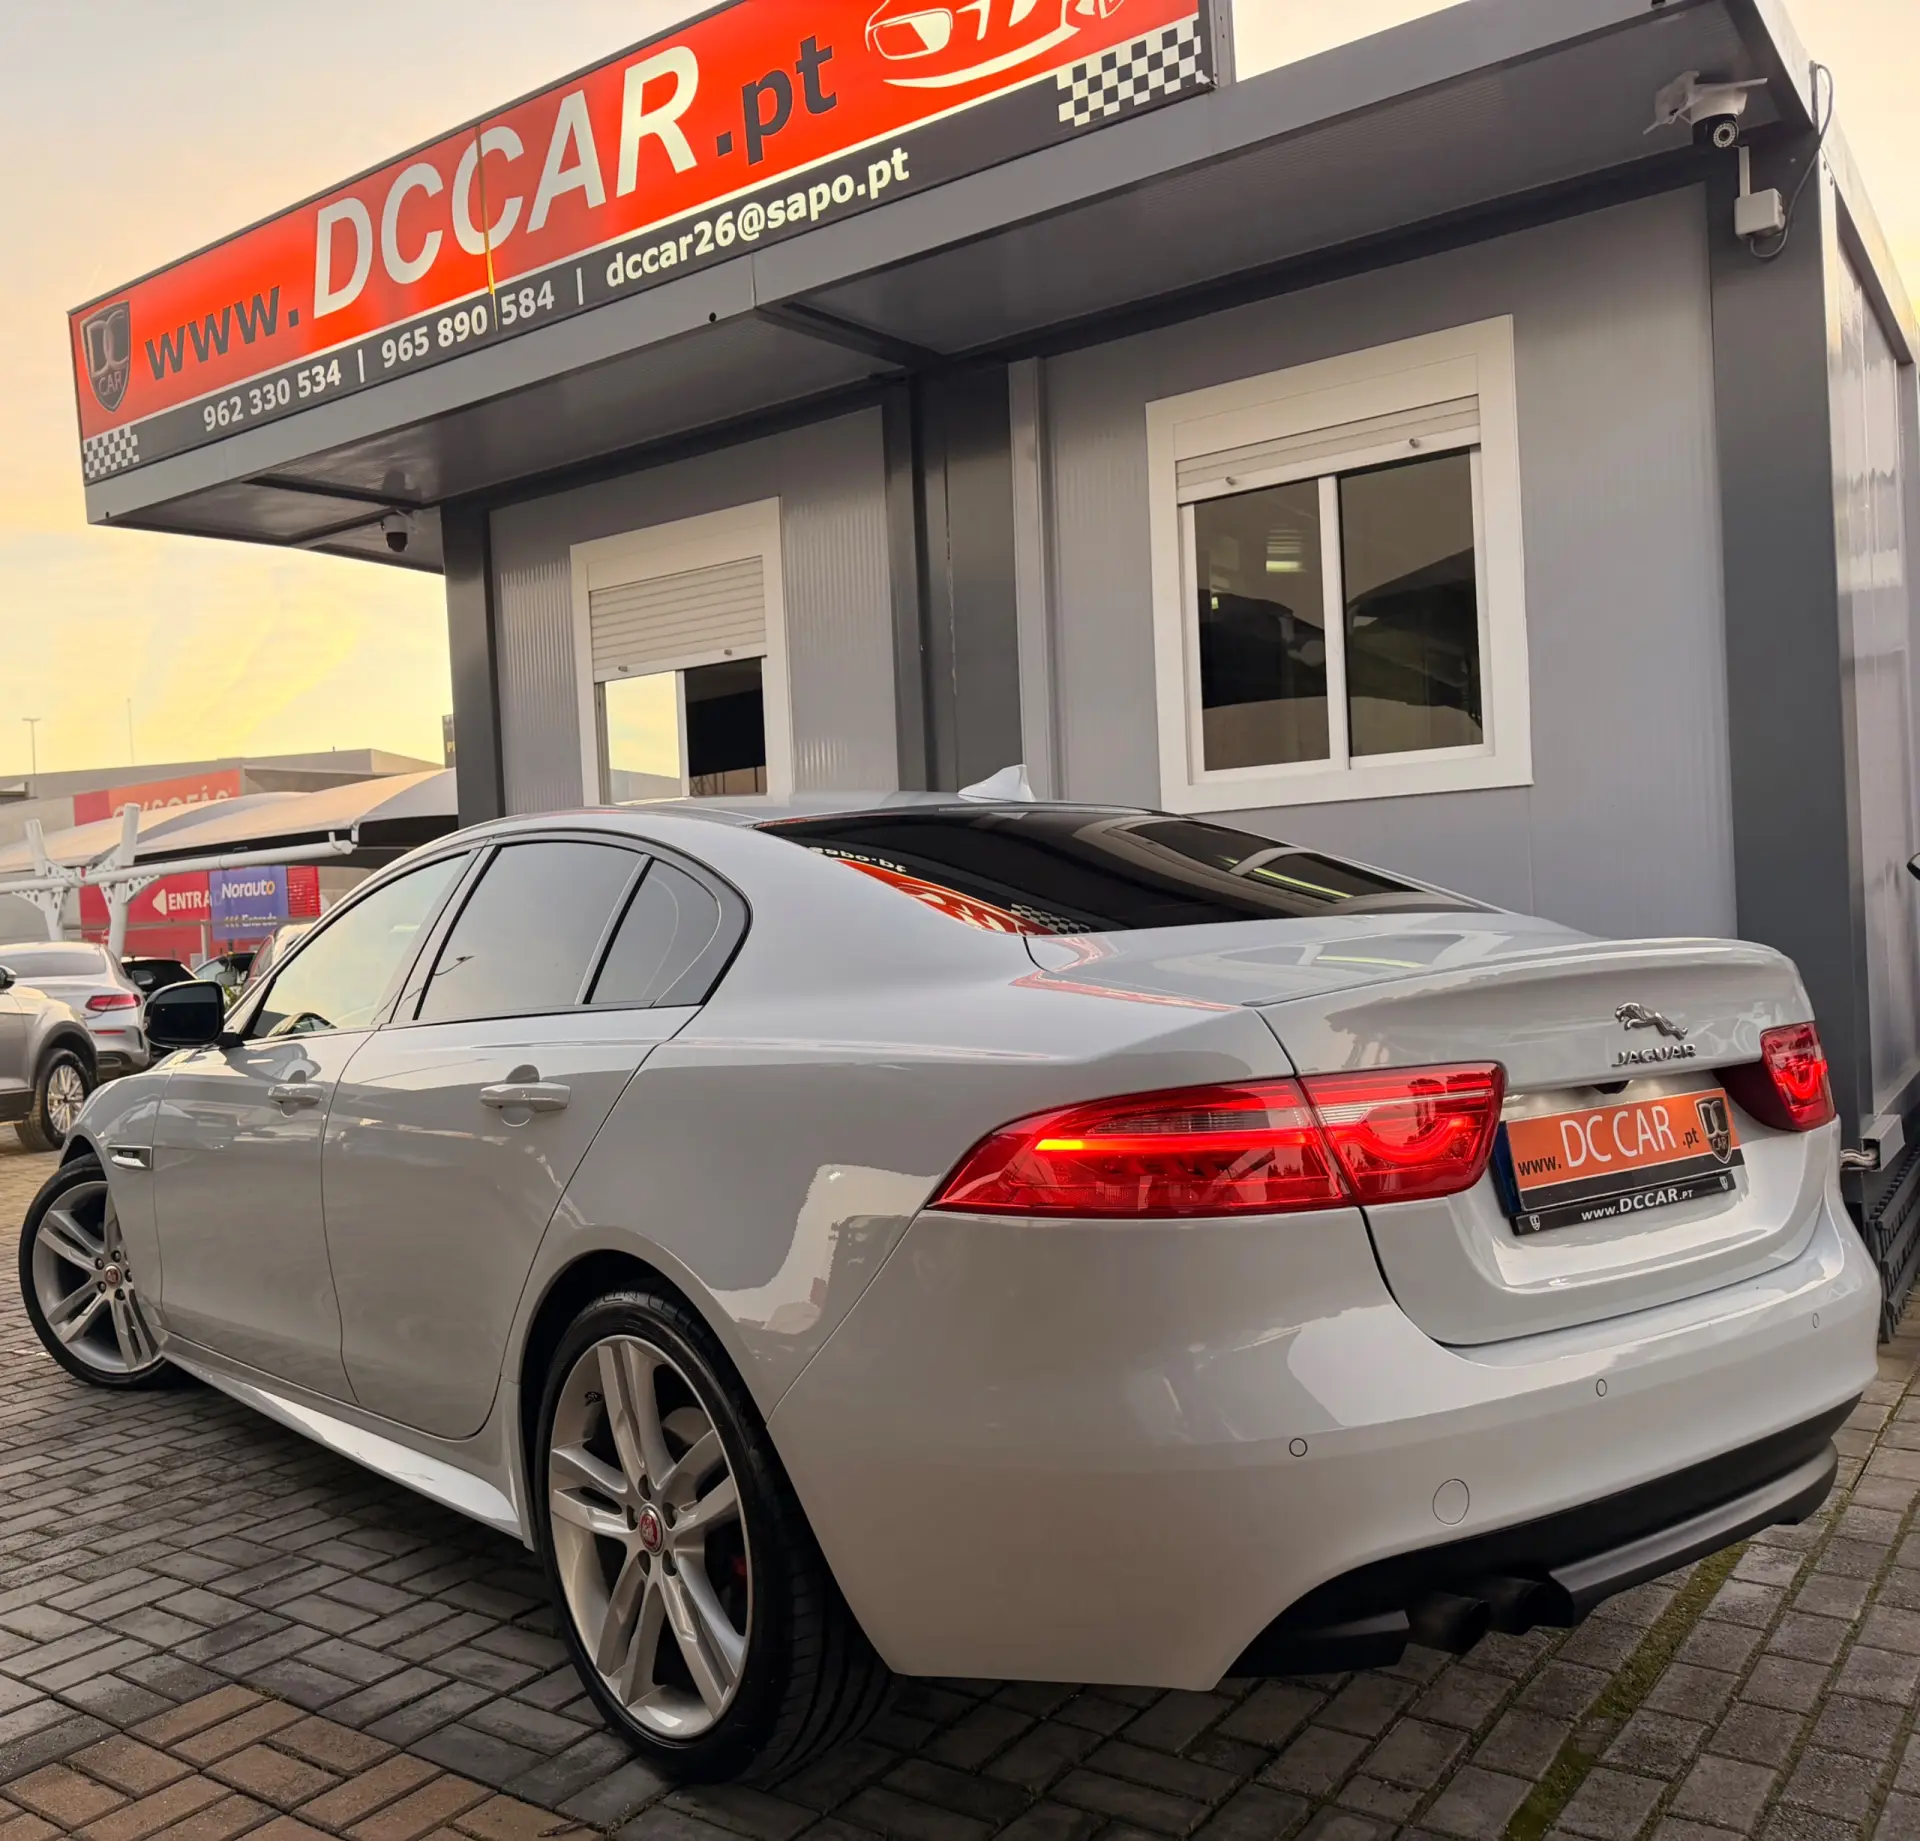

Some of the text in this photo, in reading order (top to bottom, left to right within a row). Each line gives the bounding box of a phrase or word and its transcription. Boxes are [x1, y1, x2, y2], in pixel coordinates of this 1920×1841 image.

[203, 147, 910, 432] 962 330 534 965 890 584 dccar26@sapo.pt
[98, 371, 123, 396] CAR
[221, 880, 275, 899] Norauto
[1611, 1043, 1697, 1068] JAGUAR
